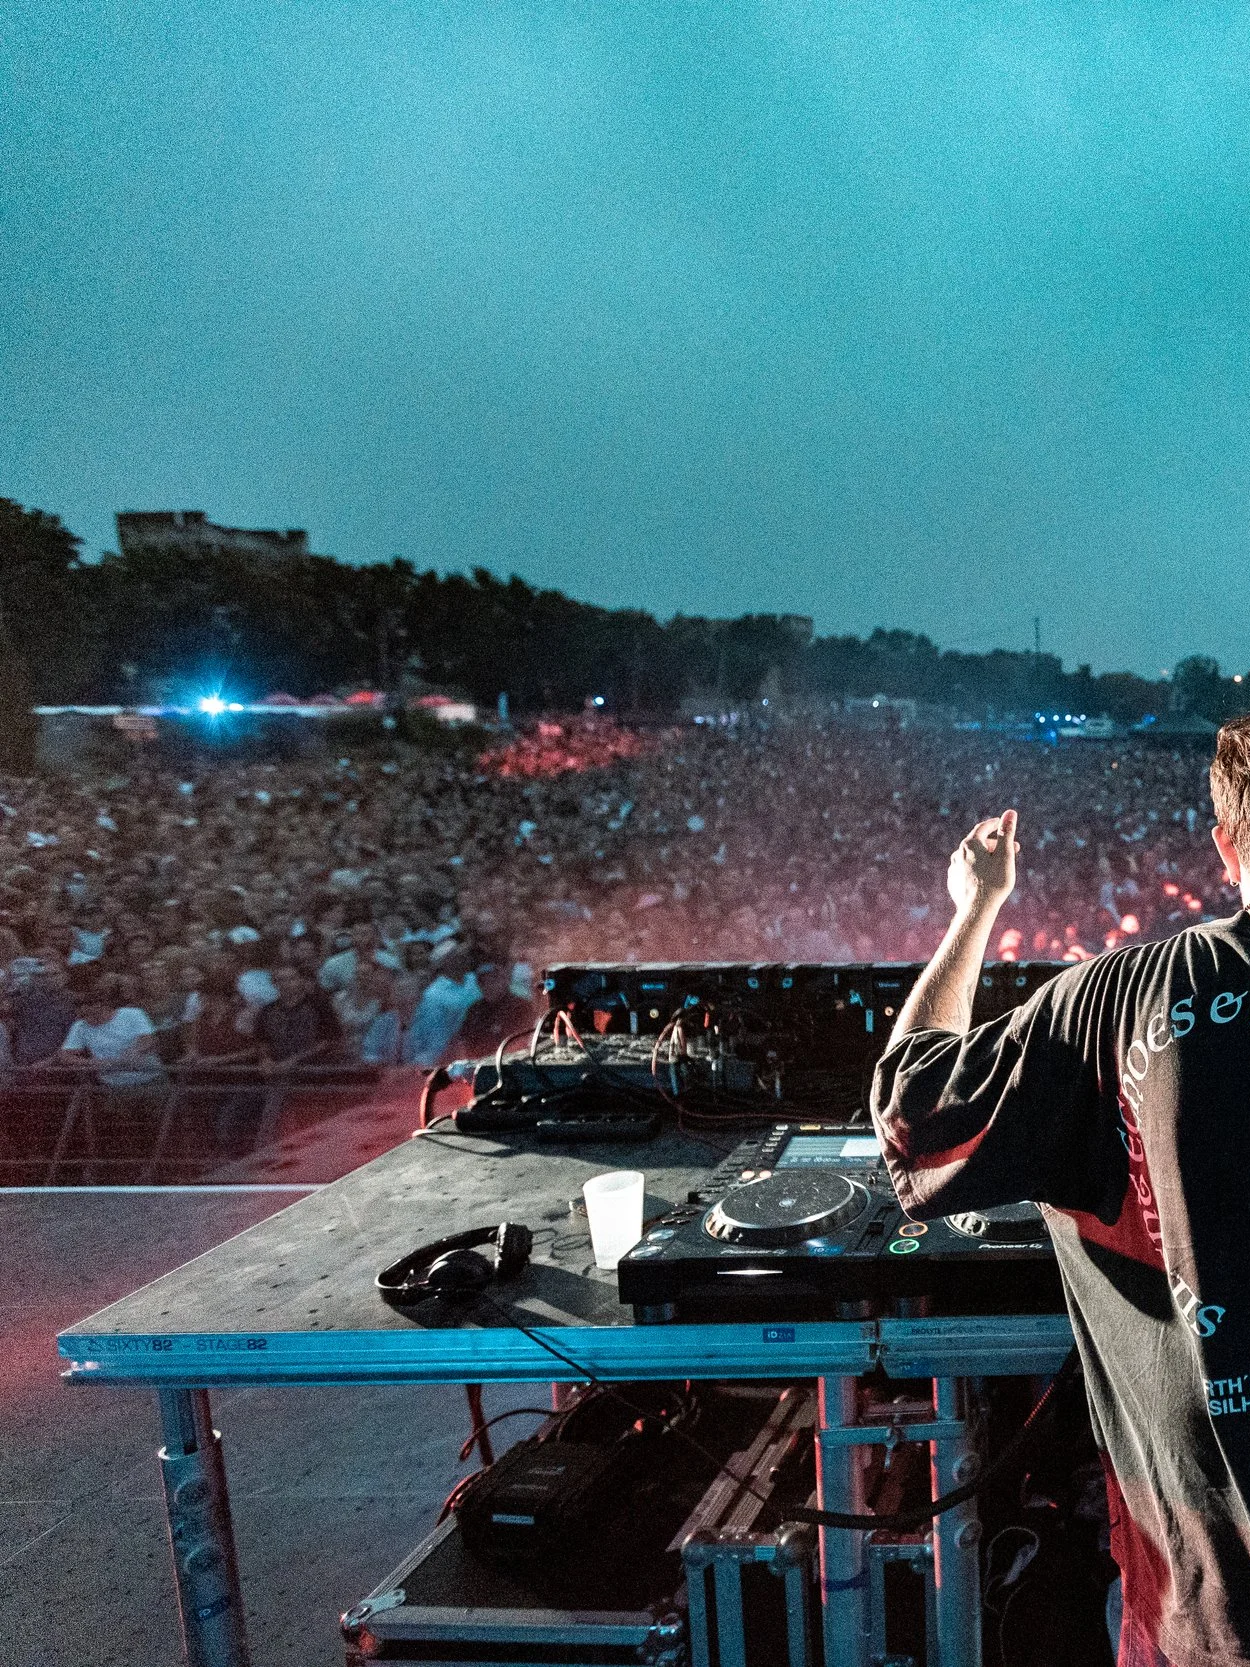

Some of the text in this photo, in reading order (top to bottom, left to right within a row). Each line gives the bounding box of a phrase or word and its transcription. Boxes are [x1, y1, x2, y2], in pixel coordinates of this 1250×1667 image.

[1210, 991, 1248, 1024] &
[106, 1338, 173, 1351] SIXTY82
[196, 1338, 268, 1351] STAGE82
